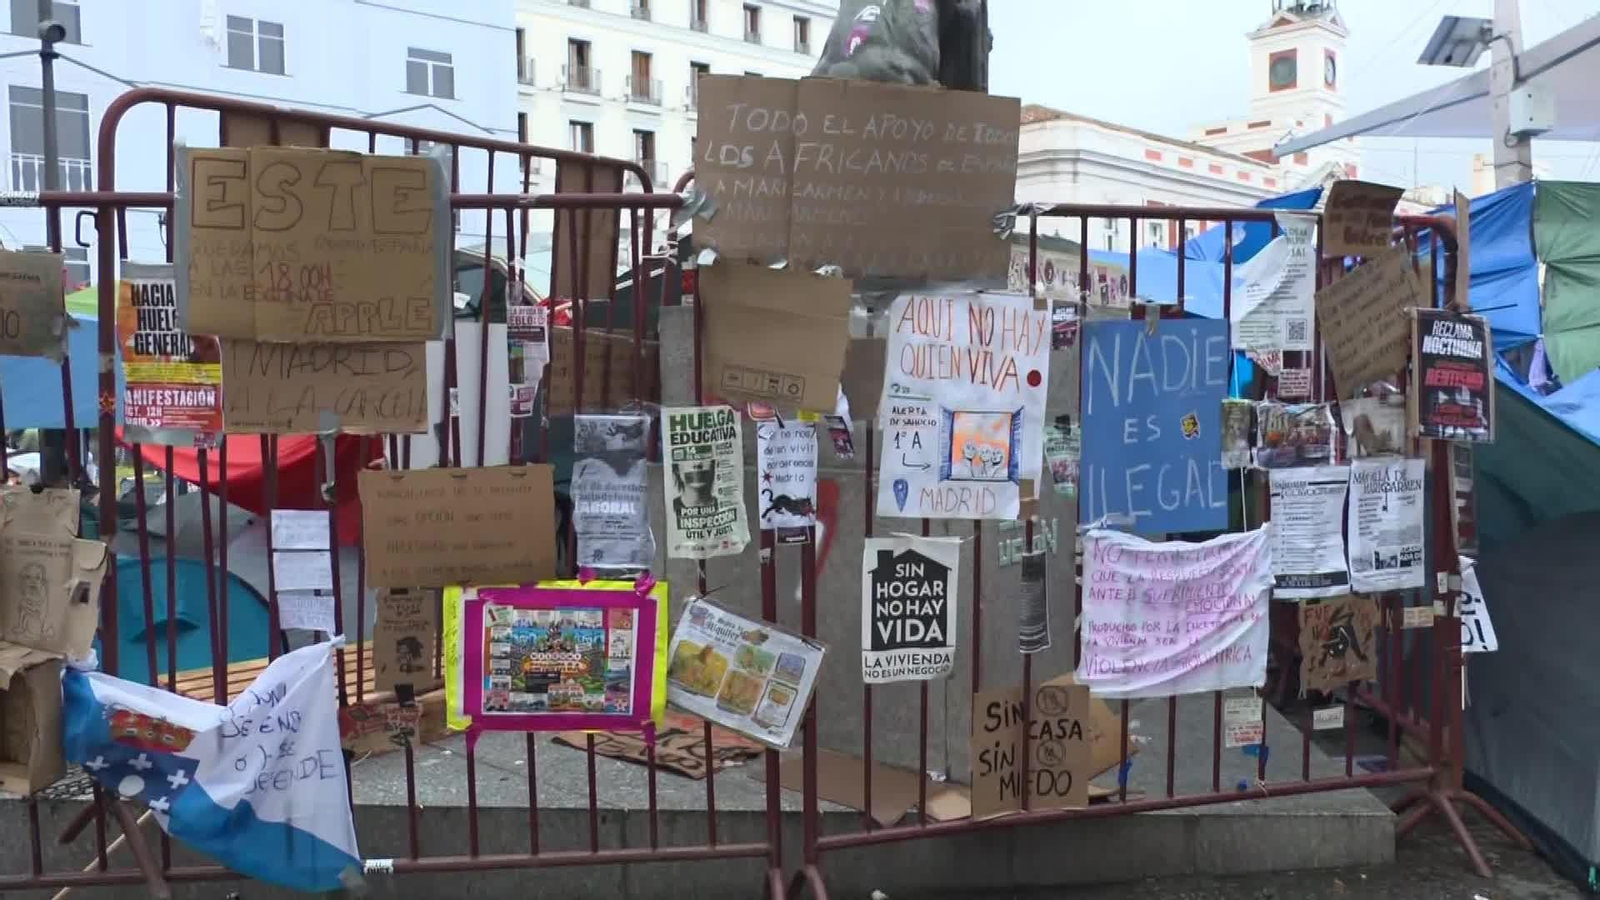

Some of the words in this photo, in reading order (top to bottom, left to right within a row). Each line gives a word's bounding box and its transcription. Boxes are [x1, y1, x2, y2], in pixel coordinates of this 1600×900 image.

[726, 103, 808, 135] TODO
[823, 114, 855, 135] EL
[862, 114, 935, 142] APOYO
[704, 143, 754, 168] LOS
[192, 157, 434, 235] ESTE
[131, 283, 175, 307] HACIA
[305, 298, 432, 334] APPLE
[968, 302, 995, 346] NO
[1001, 306, 1046, 356] HAY
[1432, 320, 1474, 341] RECLAMA
[900, 343, 961, 380] QUIEN
[967, 348, 1020, 393] VIVA
[1088, 328, 1226, 415] NADIE
[669, 409, 736, 432] HUELGA
[1123, 414, 1161, 444] ES
[670, 425, 737, 446] EDUCATIVA
[911, 430, 923, 449] A
[681, 507, 699, 516] POR
[919, 485, 996, 516] MADRID
[706, 528, 713, 537] Y
[894, 562, 925, 578] SIN
[876, 580, 944, 599] HOGAR
[876, 600, 904, 618] NO
[906, 599, 944, 616] HAY
[877, 618, 944, 645] VIDA
[864, 657, 882, 669] LA
[886, 653, 951, 667] VIVIENDA
[864, 669, 879, 679] NO
[881, 668, 892, 678] ES
[892, 667, 906, 677] UN
[907, 664, 949, 676] NEGOCIO
[1027, 719, 1082, 741] CASA
[979, 739, 1015, 777] SIN
